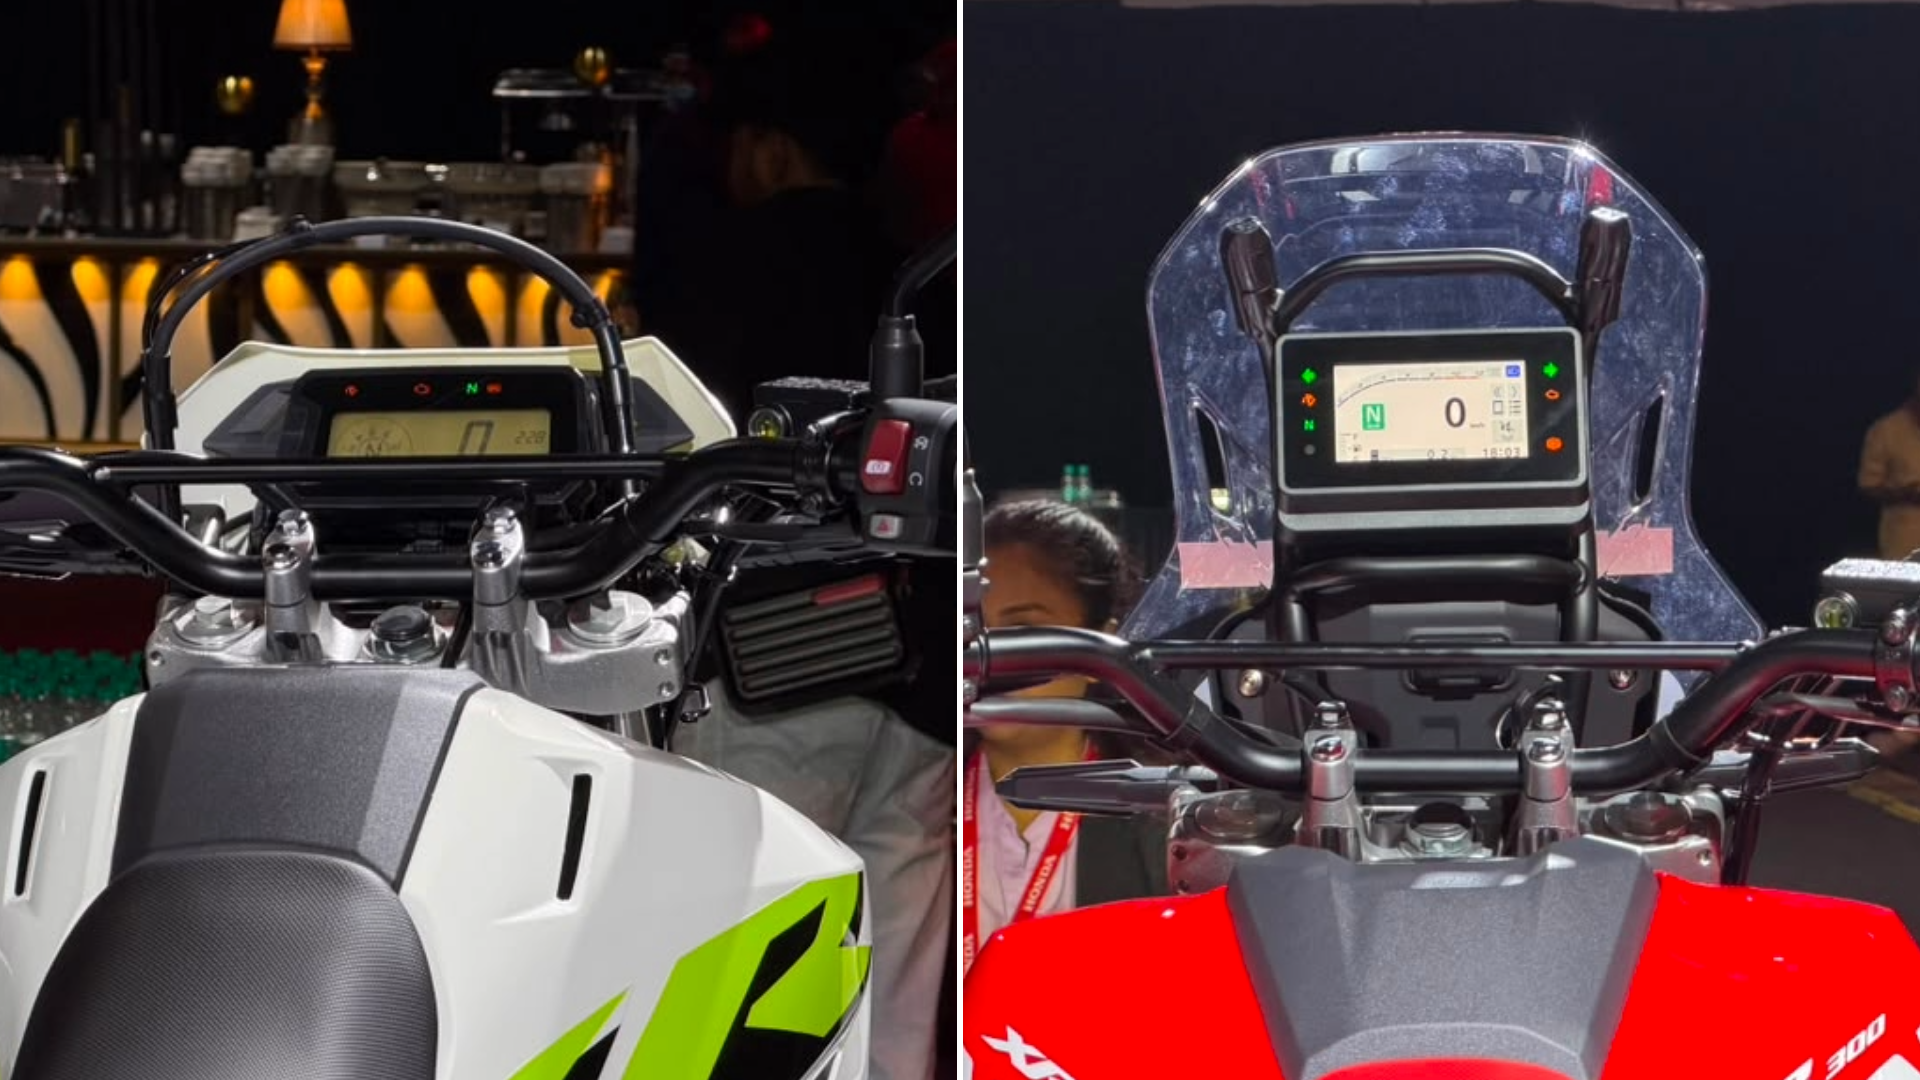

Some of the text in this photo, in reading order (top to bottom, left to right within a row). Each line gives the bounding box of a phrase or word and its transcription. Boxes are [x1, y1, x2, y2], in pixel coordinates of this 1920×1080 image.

[466, 382, 478, 395] N
[1304, 419, 1314, 431] N
[1366, 404, 1381, 422] N
[1445, 397, 1466, 427] 0
[964, 846, 974, 908] HONDA
[1022, 854, 1057, 912] HONDA
[1825, 1013, 1886, 1080] 300
